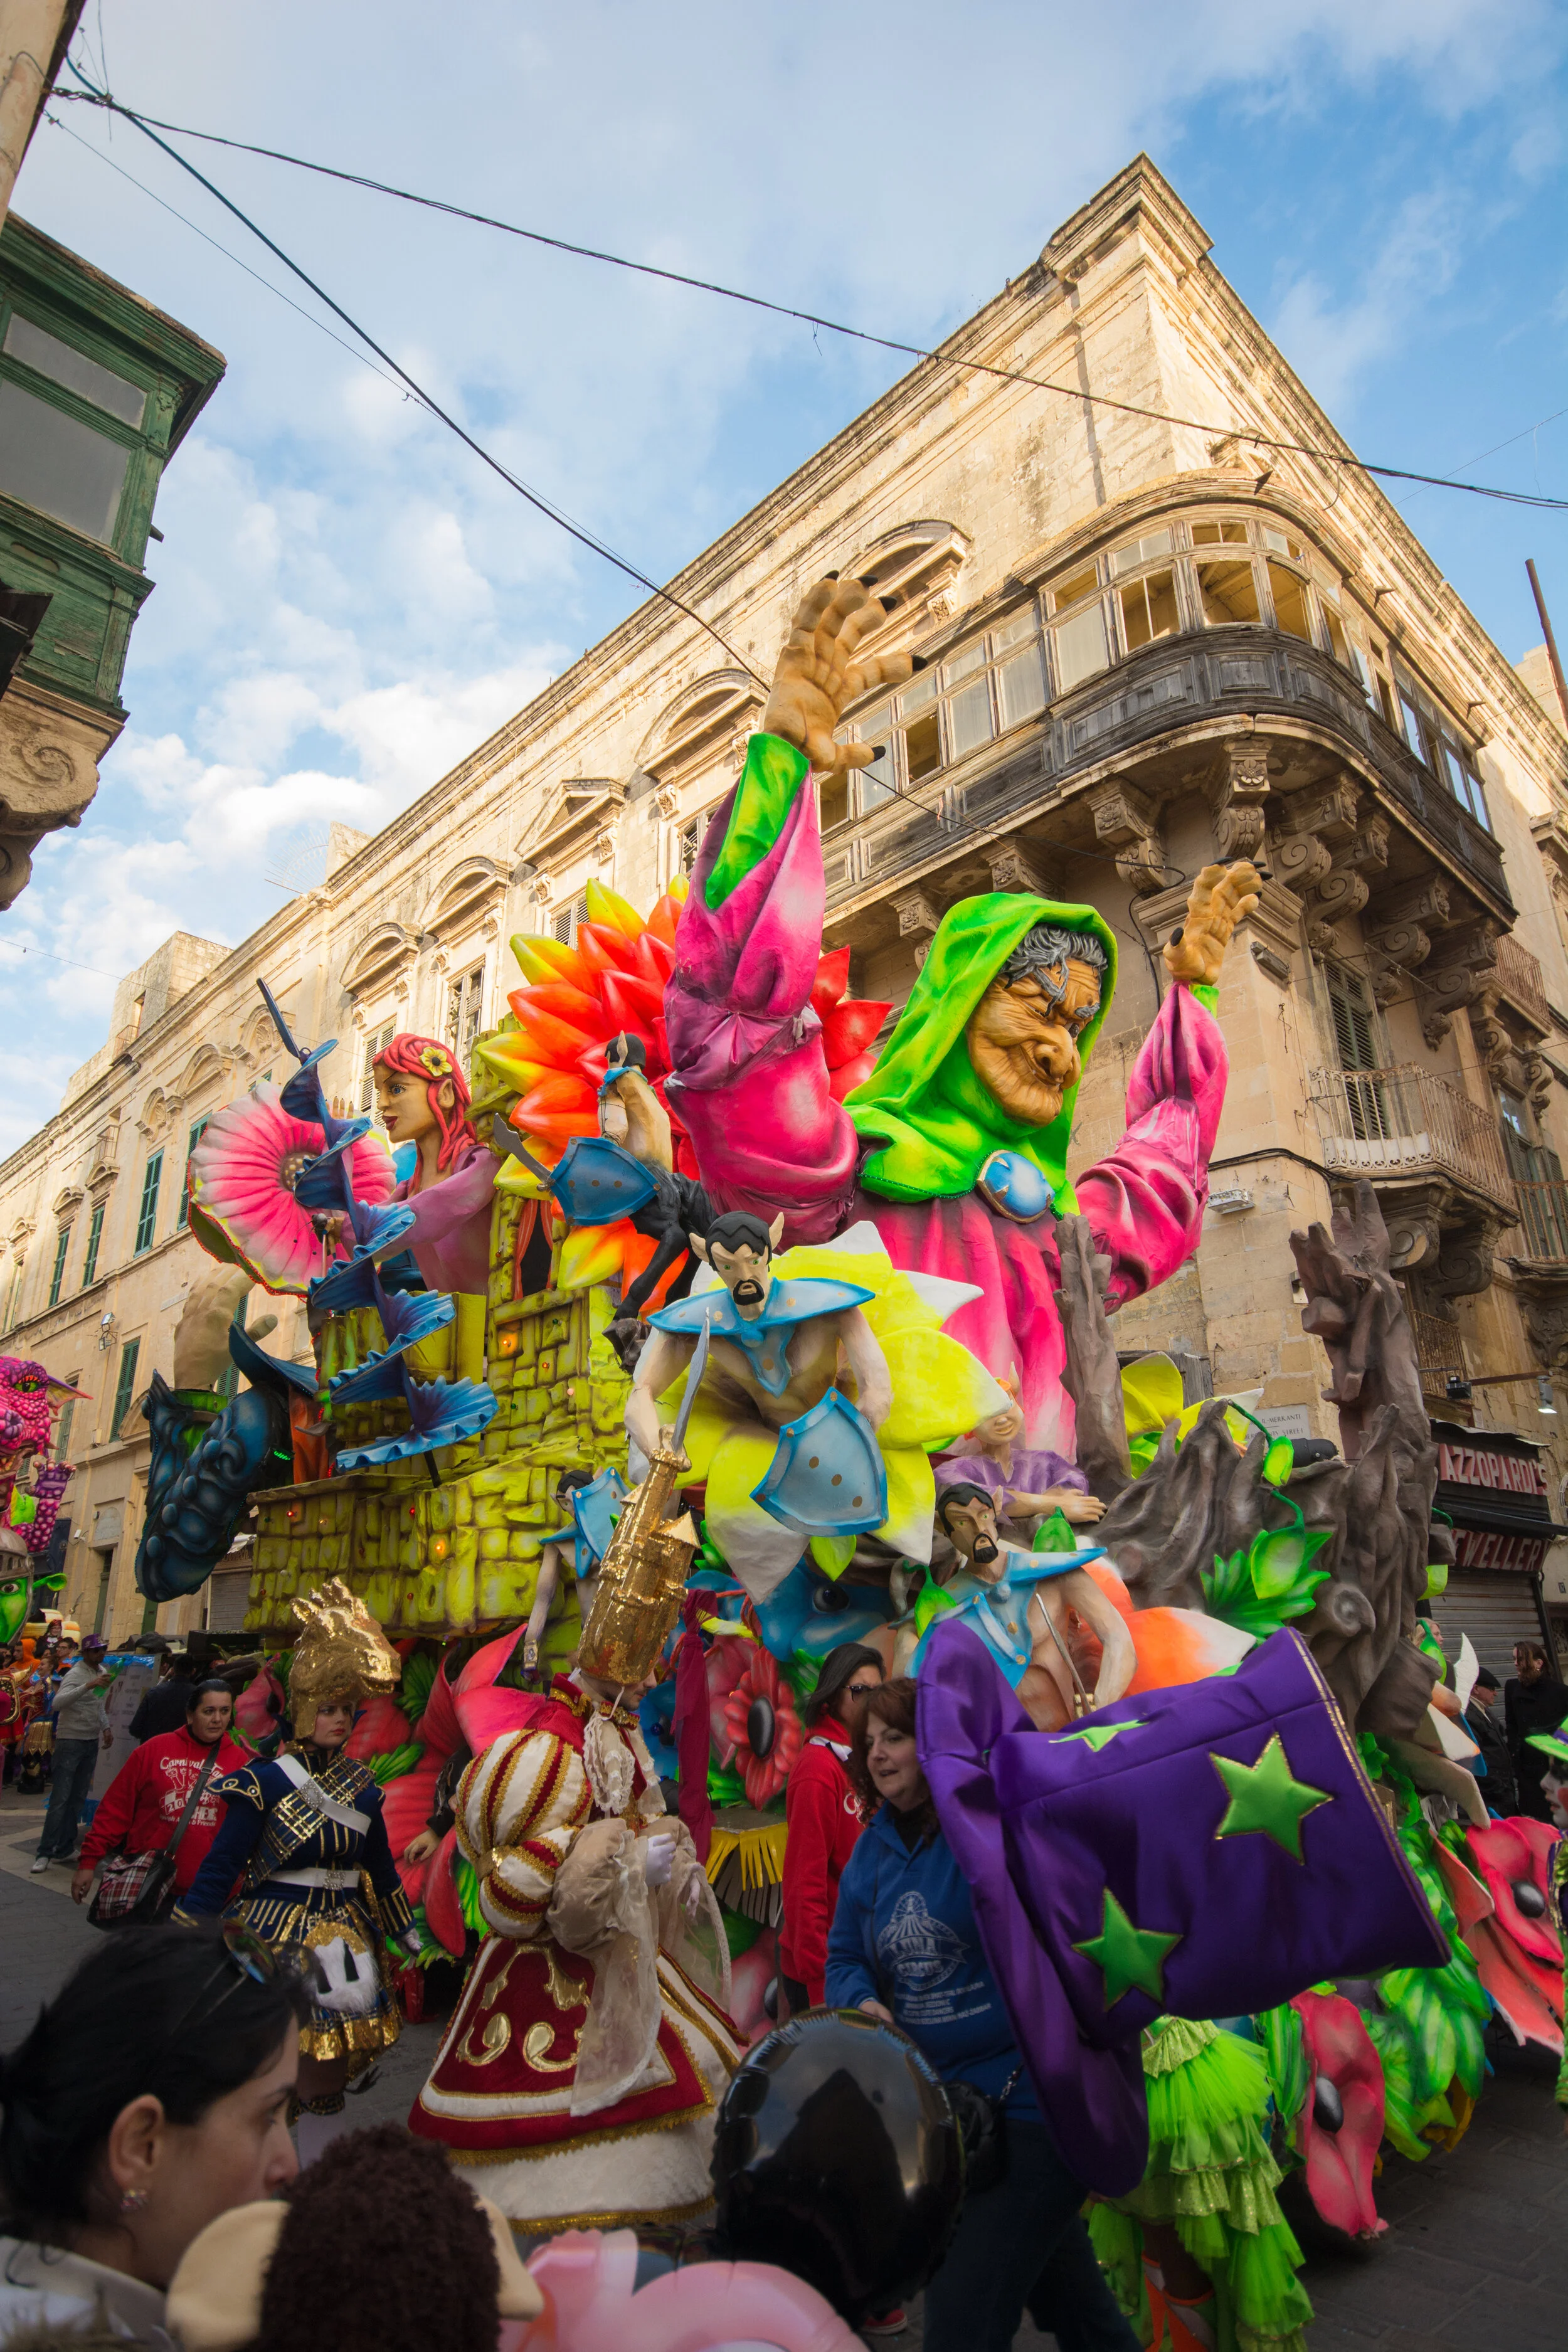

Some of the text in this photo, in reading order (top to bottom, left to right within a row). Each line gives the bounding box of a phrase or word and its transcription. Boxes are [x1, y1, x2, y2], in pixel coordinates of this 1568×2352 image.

[1261, 1414, 1301, 1424] IL-MERKANTI
[1282, 1428, 1303, 1436] STREET
[1440, 1443, 1550, 1496] AZZOPARDI'S
[1453, 1529, 1550, 1571] EWELLERY
[159, 1757, 205, 1770] Carnival
[897, 1960, 944, 1977] CIRCUS
